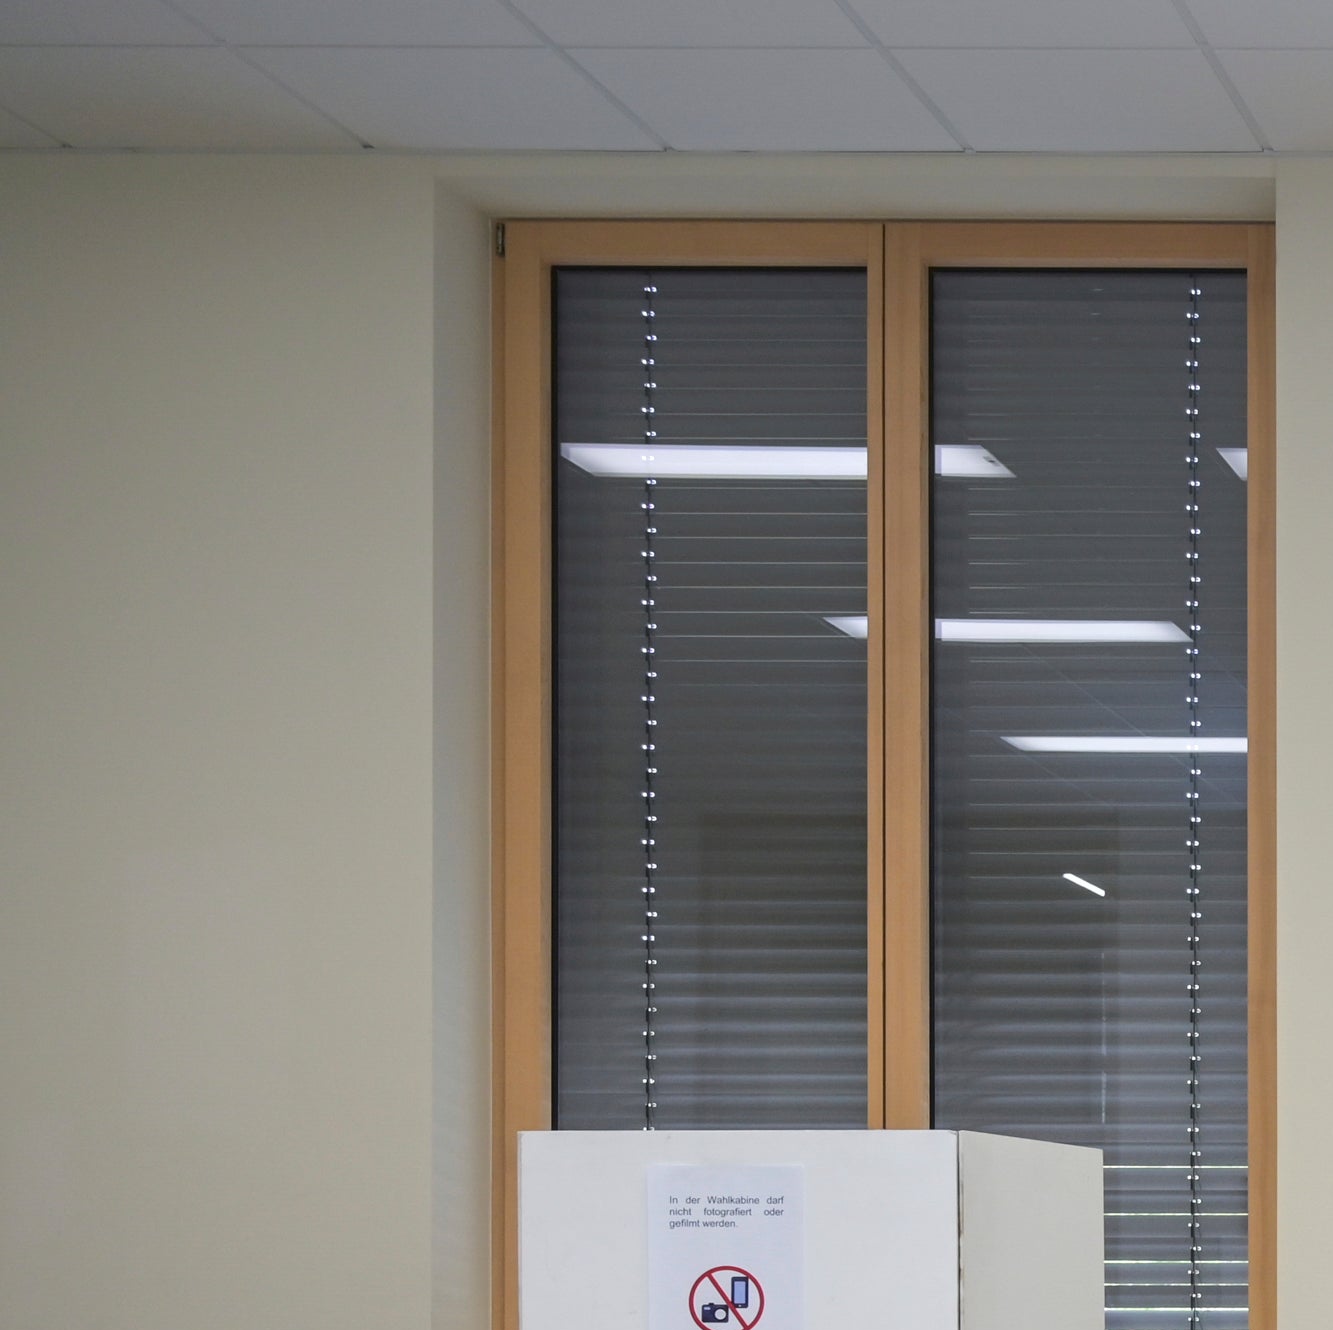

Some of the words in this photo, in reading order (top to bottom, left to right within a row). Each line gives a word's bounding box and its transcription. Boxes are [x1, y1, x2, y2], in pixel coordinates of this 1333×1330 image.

[669, 1196, 678, 1205] In
[686, 1196, 701, 1205] der
[707, 1196, 760, 1205] Wahlkabine
[767, 1196, 784, 1205] darf
[669, 1207, 692, 1217] nicht
[704, 1207, 752, 1217] fotografiert
[764, 1207, 784, 1217] oder
[669, 1219, 700, 1229] gefilmt
[703, 1219, 738, 1228] werden.
